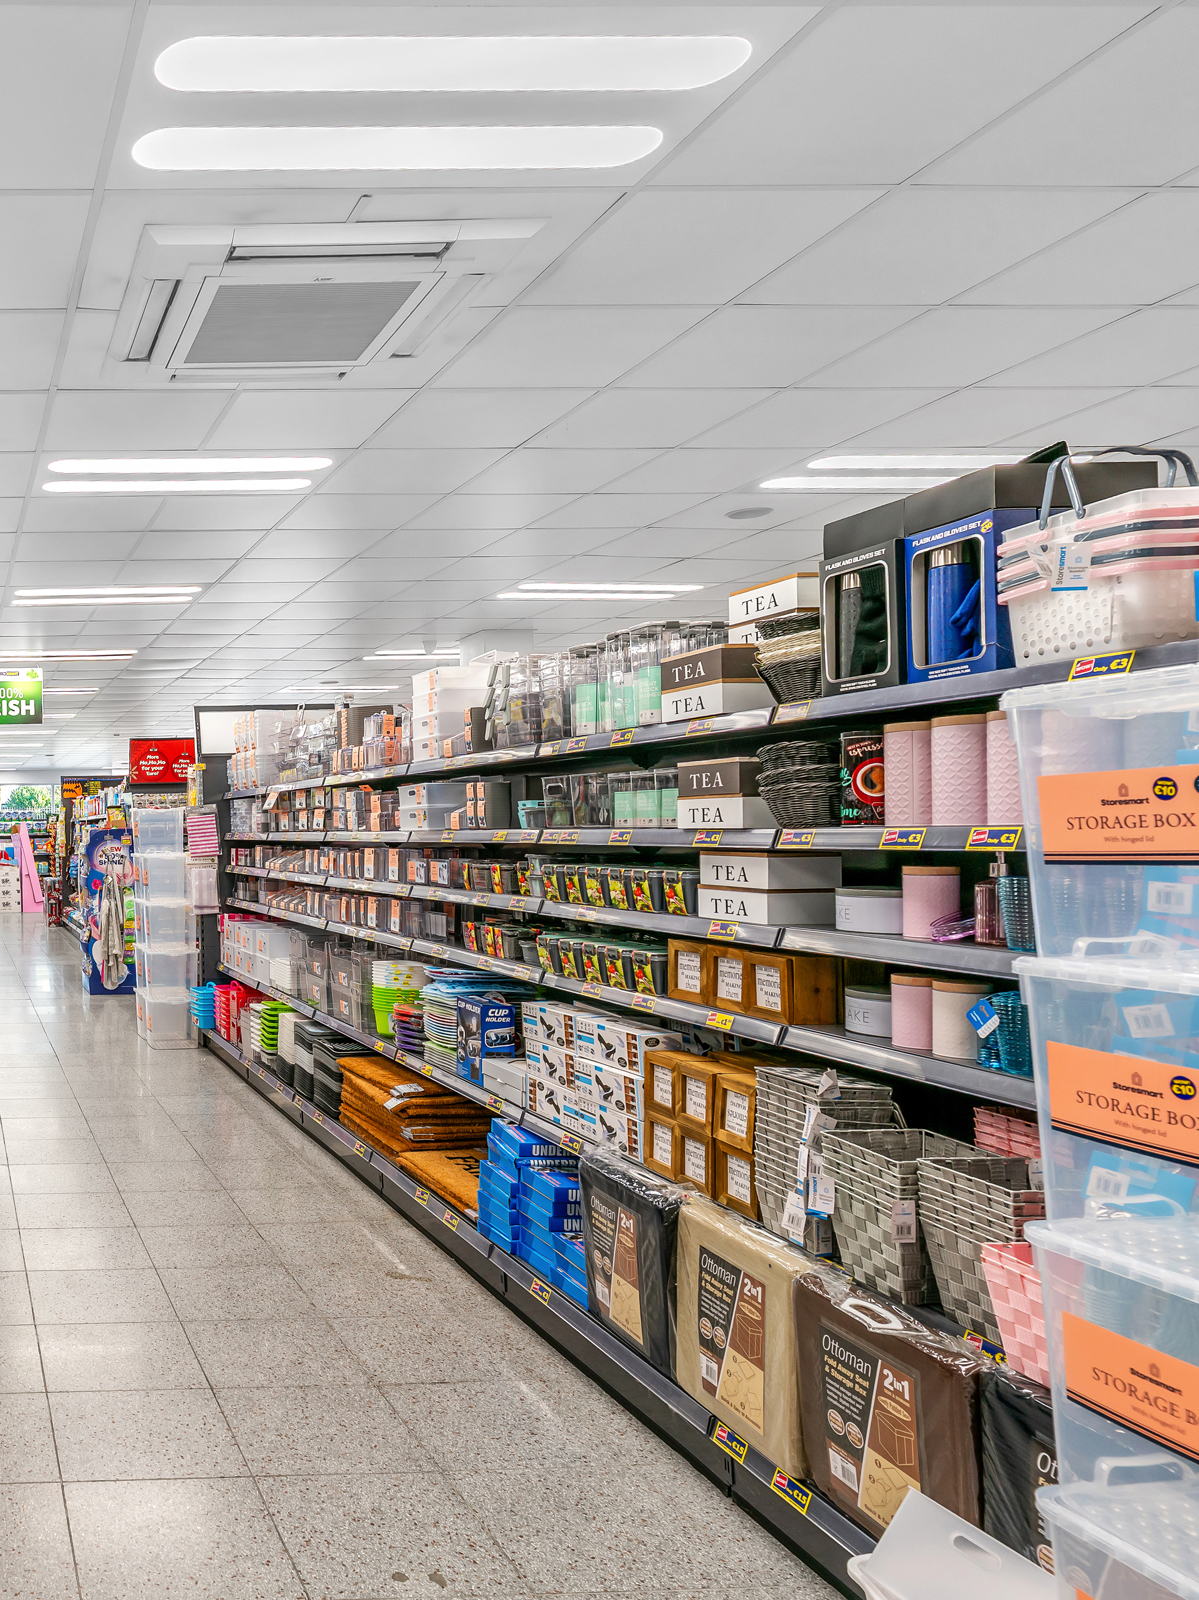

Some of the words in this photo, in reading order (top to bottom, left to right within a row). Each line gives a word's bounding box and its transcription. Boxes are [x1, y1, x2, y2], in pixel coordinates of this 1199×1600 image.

[912, 537, 931, 548] FLASK
[931, 532, 943, 542] AND
[943, 524, 968, 538] GLOVES
[968, 520, 982, 531] SET
[825, 560, 842, 571] FLASK
[841, 558, 852, 567] AND
[852, 553, 874, 564] GLOVES
[874, 548, 886, 558] SET
[1056, 546, 1067, 586] Storesmart
[741, 592, 779, 616] TEA
[671, 660, 706, 683] TEA
[1093, 665, 1108, 673] Only
[1110, 657, 1129, 671] €3
[671, 694, 706, 715] TEA
[689, 771, 724, 790] TEA
[1154, 785, 1176, 796] €10
[1101, 797, 1150, 807] Storesmart
[688, 807, 724, 824] TEA
[1066, 814, 1149, 830] STORAGE
[1153, 812, 1197, 829] BOX
[908, 834, 921, 843] €3
[1000, 833, 1015, 843] €3
[1121, 835, 1145, 845] hinged
[1145, 835, 1155, 843] lid
[711, 864, 750, 883] TEA
[710, 898, 749, 917] TEA
[466, 1003, 481, 1015] HOLDER
[488, 1008, 509, 1017] CUP
[846, 1009, 870, 1024] AKE
[1112, 1081, 1164, 1099] Storesmart
[1171, 1084, 1195, 1096] €10
[1075, 1090, 1163, 1123] STORAGE
[1167, 1110, 1199, 1131] BO
[1113, 1118, 1131, 1129] With
[1132, 1121, 1156, 1136] hinged
[1157, 1128, 1168, 1138] lid
[590, 1195, 616, 1222] Ottoman
[701, 1253, 737, 1287] Ottoman
[743, 1278, 762, 1304] 2in1
[822, 1334, 871, 1378] Ottoman
[824, 1354, 837, 1368] Fold
[837, 1363, 854, 1380] Away
[855, 1374, 870, 1389] Seat
[830, 1368, 854, 1388] Storage
[854, 1383, 867, 1397] Box
[883, 1368, 910, 1401] 2in1
[1091, 1366, 1181, 1420] STORAGE
[731, 1440, 745, 1455] €15
[793, 1489, 808, 1505] €15
